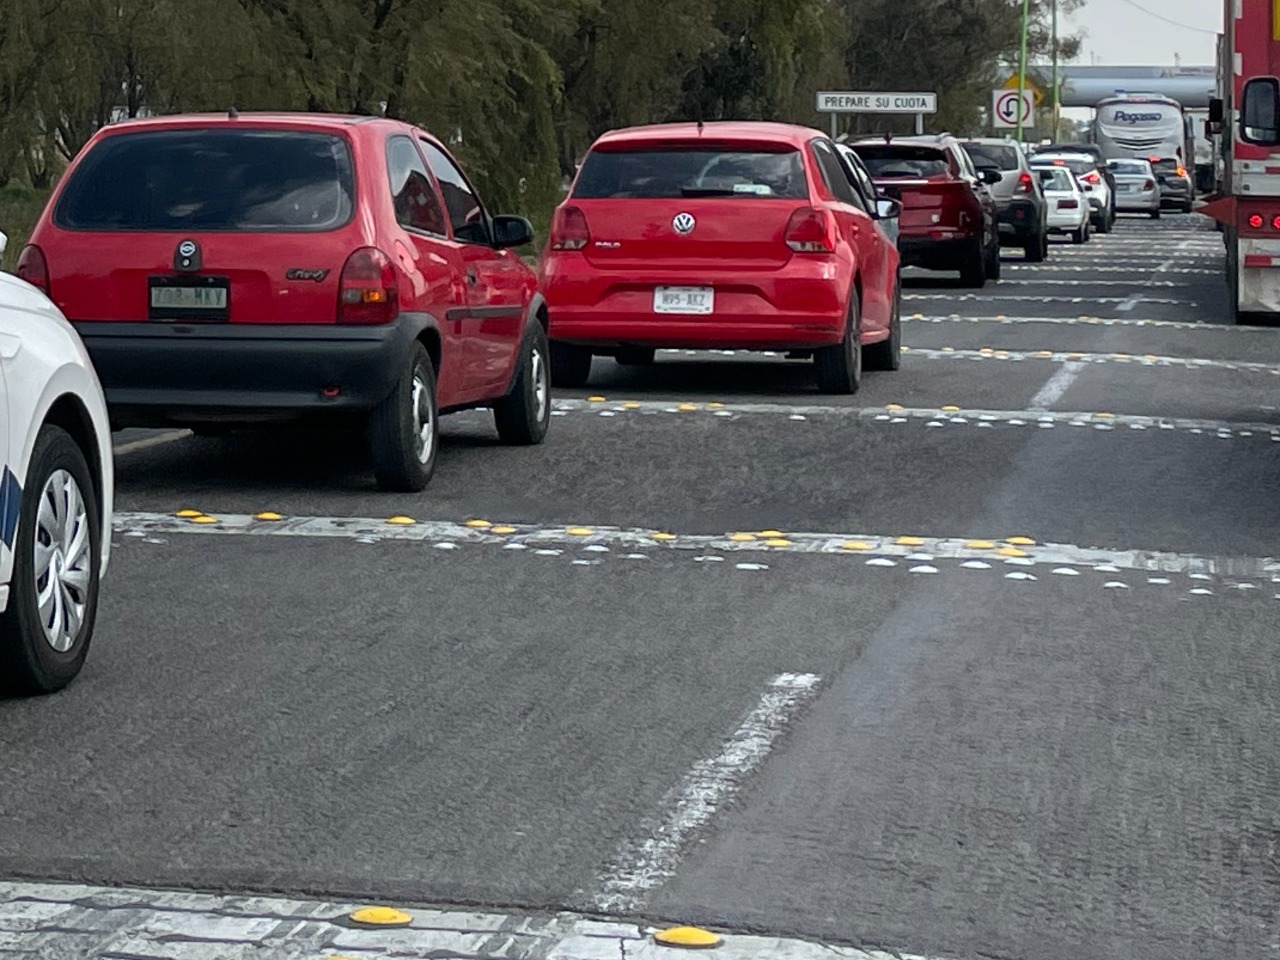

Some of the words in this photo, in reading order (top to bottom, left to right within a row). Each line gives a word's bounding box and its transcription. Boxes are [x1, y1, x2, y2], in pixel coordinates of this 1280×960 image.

[824, 96, 871, 108] PREPARE
[875, 97, 890, 109] SU
[894, 97, 928, 109] CUOTA
